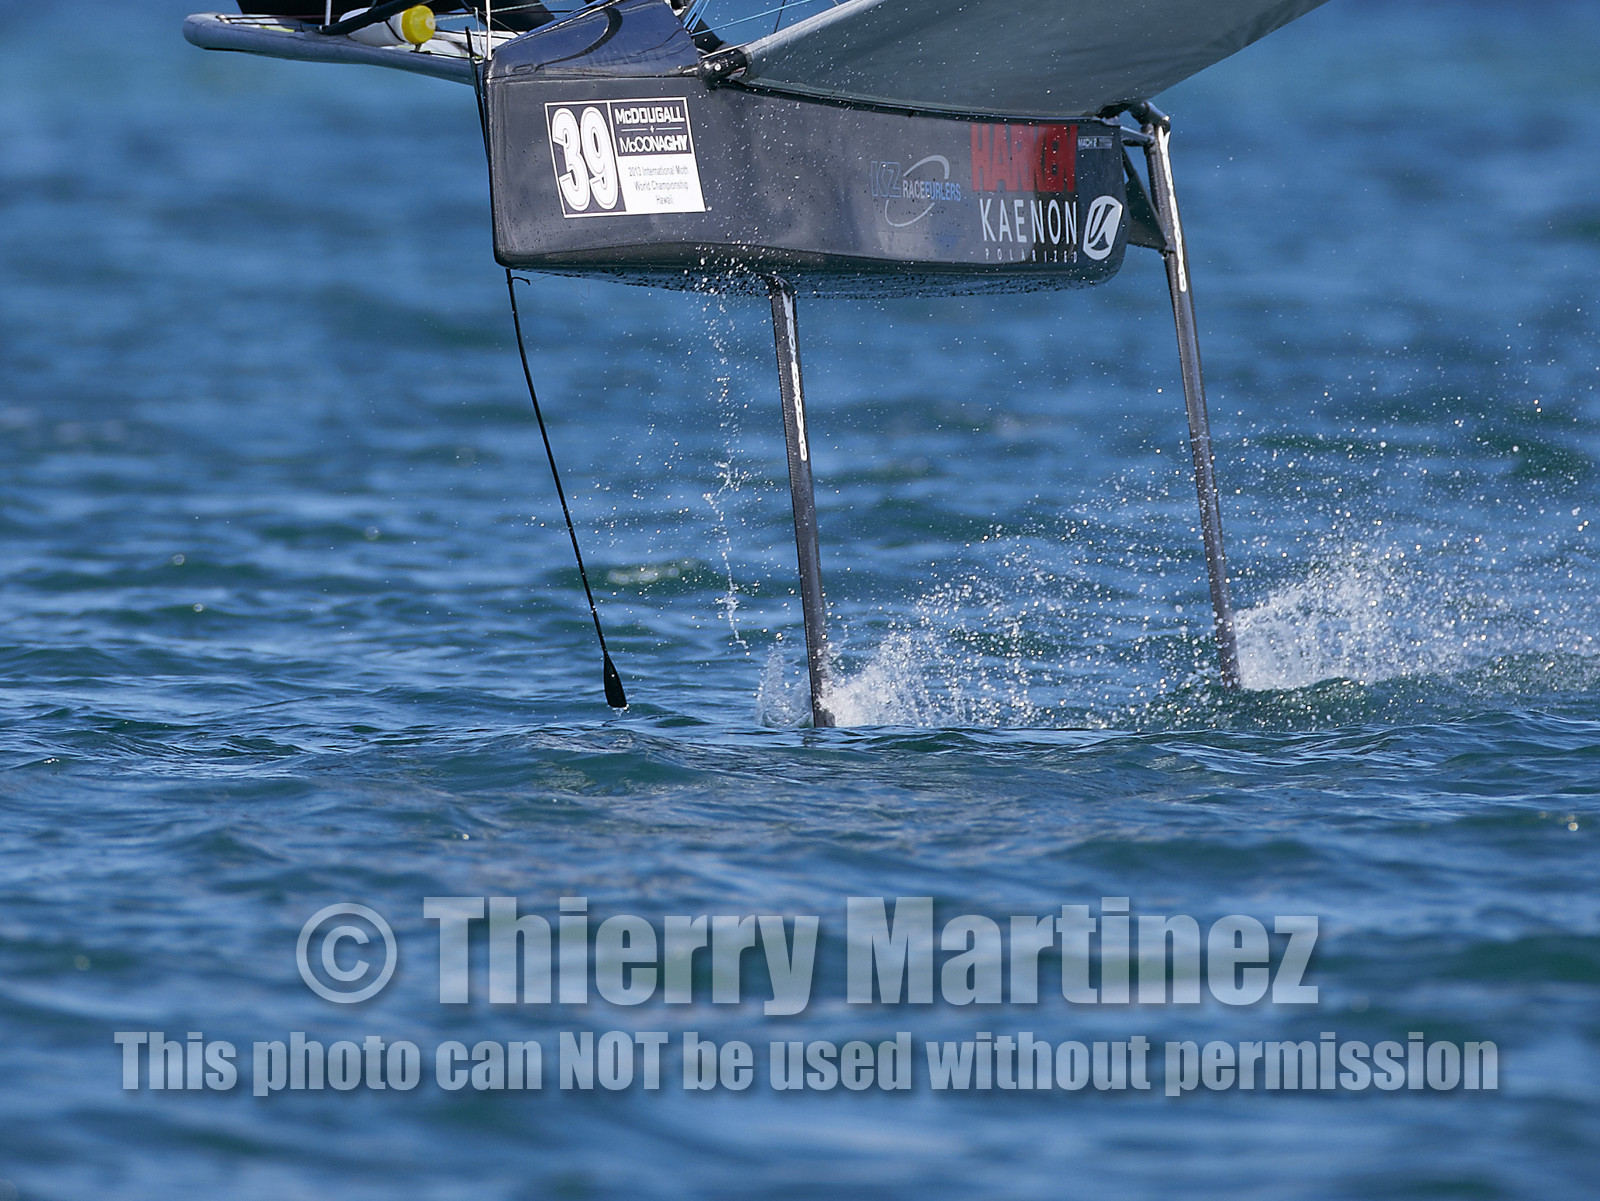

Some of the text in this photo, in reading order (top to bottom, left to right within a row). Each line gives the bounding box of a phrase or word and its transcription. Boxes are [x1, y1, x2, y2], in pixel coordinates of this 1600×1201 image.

[614, 106, 685, 124] McDOUGALL
[551, 106, 619, 212] 39
[634, 181, 651, 191] World
[979, 199, 1077, 245] KAENON
[985, 248, 1078, 263] POLARIZED
